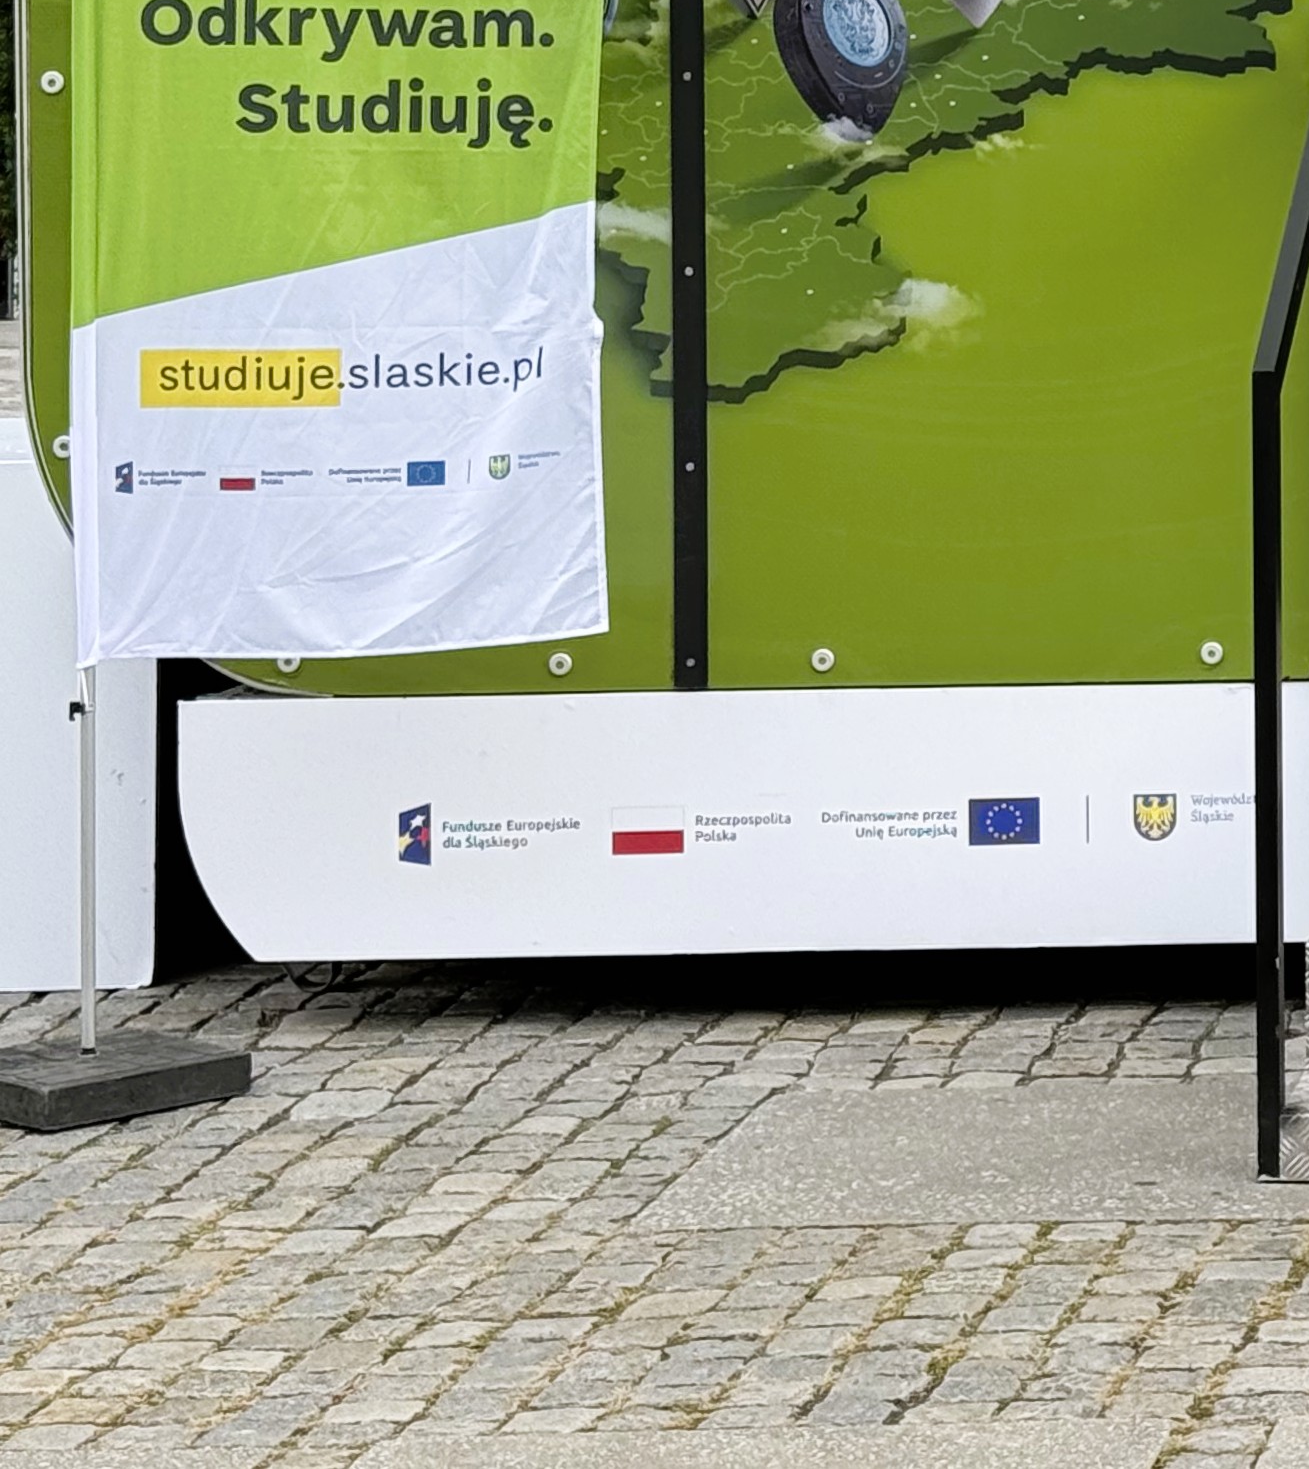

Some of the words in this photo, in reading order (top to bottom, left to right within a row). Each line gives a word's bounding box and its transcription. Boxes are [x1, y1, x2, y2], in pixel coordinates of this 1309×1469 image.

[236, 77, 554, 149] Studiuję.
[159, 346, 543, 401] studiuje.slaskie.pl
[1190, 792, 1256, 808] Wojewódz
[442, 820, 502, 833] Fundusze
[507, 817, 581, 833] Europejskie
[695, 812, 792, 829] Rzeczpospolita
[821, 809, 919, 824] Dofinansowane
[922, 809, 958, 824] przez
[695, 829, 737, 843] Polska
[855, 825, 884, 841] Unię
[888, 823, 958, 840] Europejską
[442, 835, 462, 849] dla
[465, 833, 528, 851] Śląskiego
